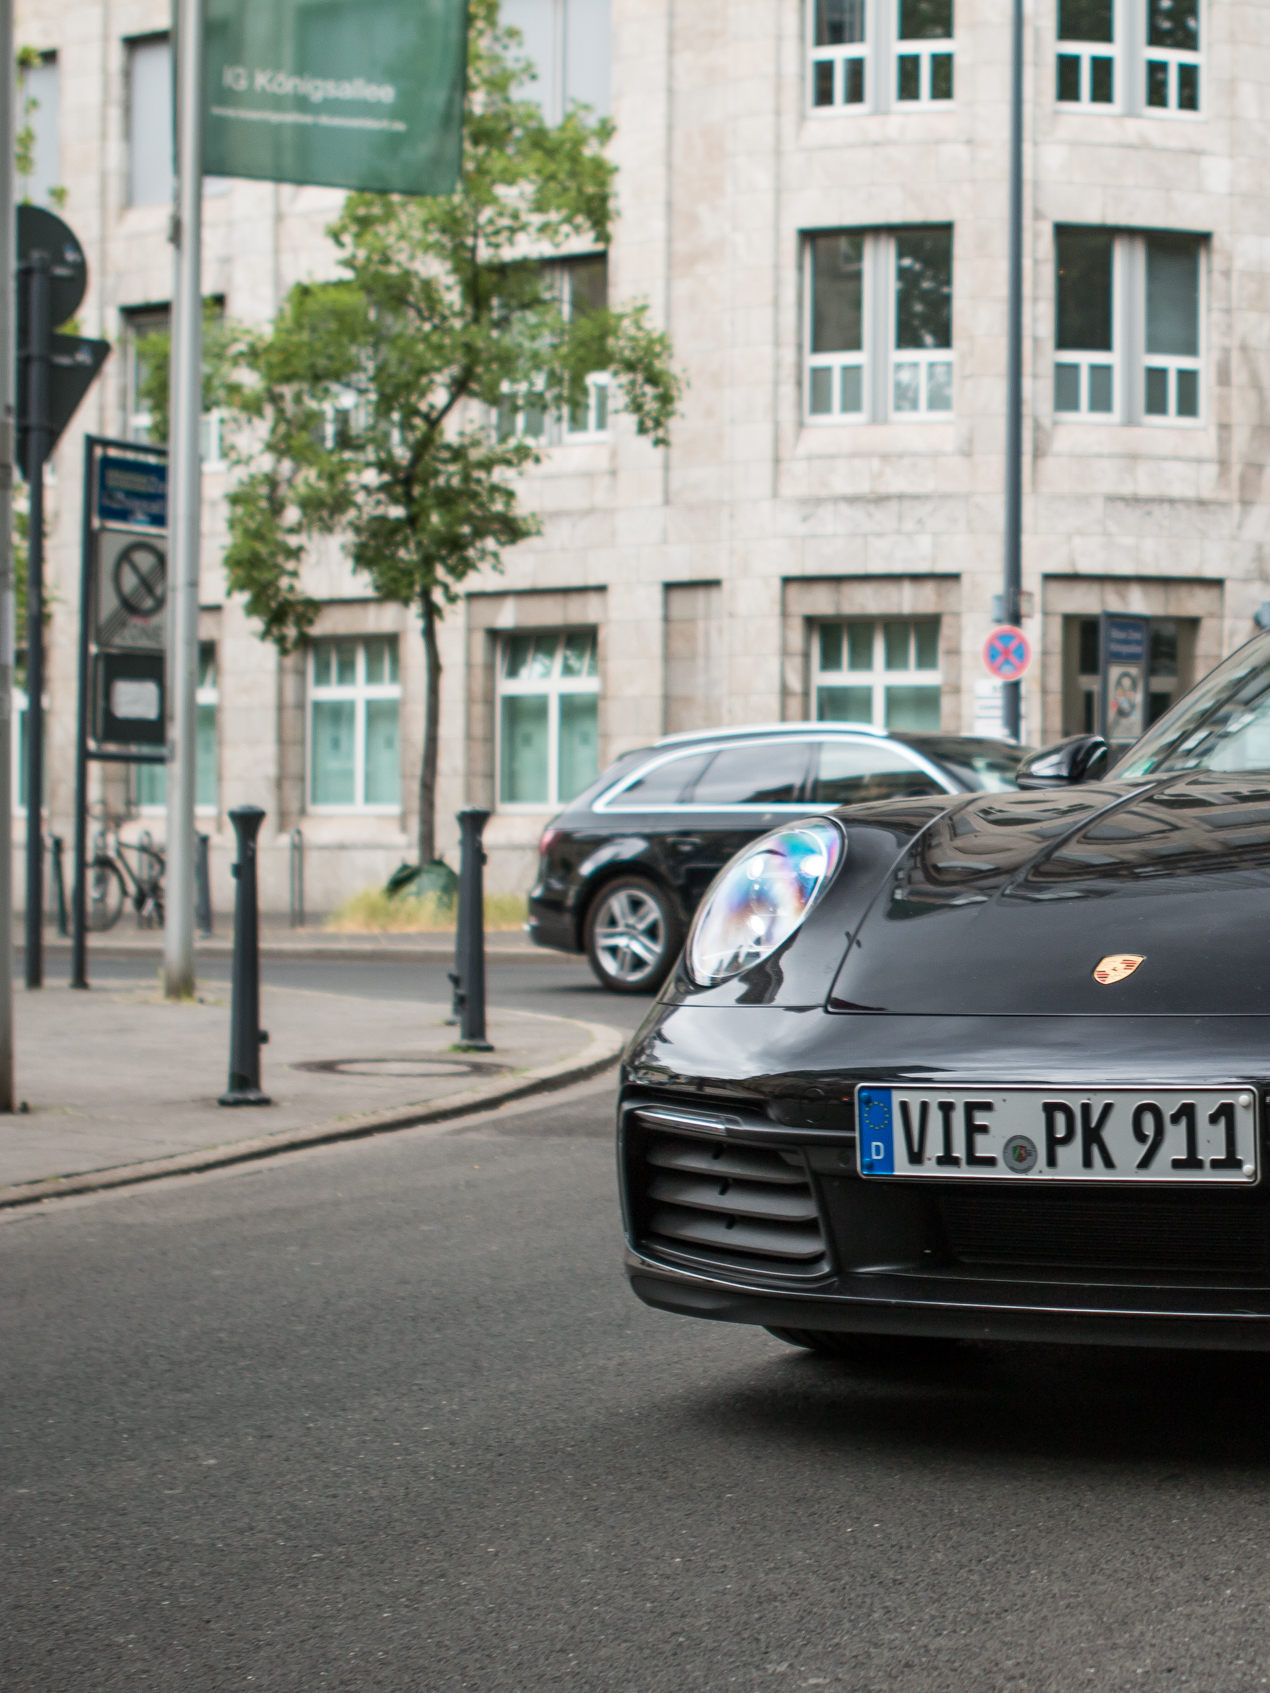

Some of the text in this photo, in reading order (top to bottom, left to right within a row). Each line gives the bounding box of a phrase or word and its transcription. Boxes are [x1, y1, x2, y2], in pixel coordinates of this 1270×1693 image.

[222, 65, 396, 104] IG Königsallee
[870, 1141, 885, 1160] D
[899, 1099, 1245, 1170] VIE PK 911
